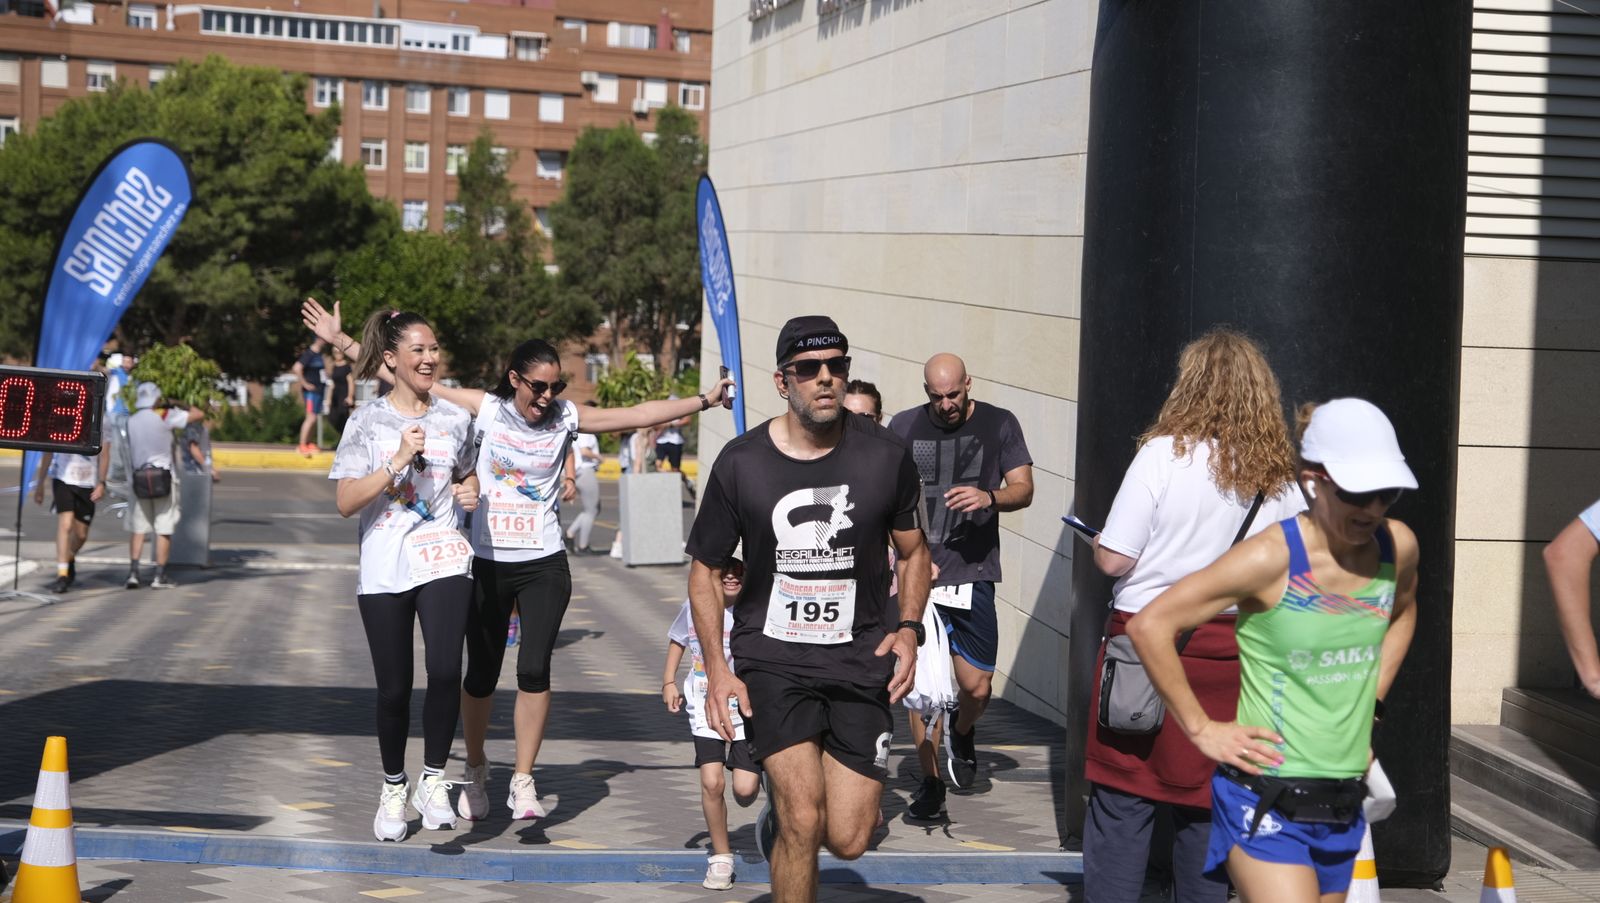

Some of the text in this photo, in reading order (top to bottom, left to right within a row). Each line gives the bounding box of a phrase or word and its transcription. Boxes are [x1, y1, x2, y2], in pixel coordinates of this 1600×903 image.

[490, 515, 535, 531] 1161
[419, 541, 469, 562] 1239
[785, 600, 840, 623] 195
[1319, 645, 1381, 667] SAKA
